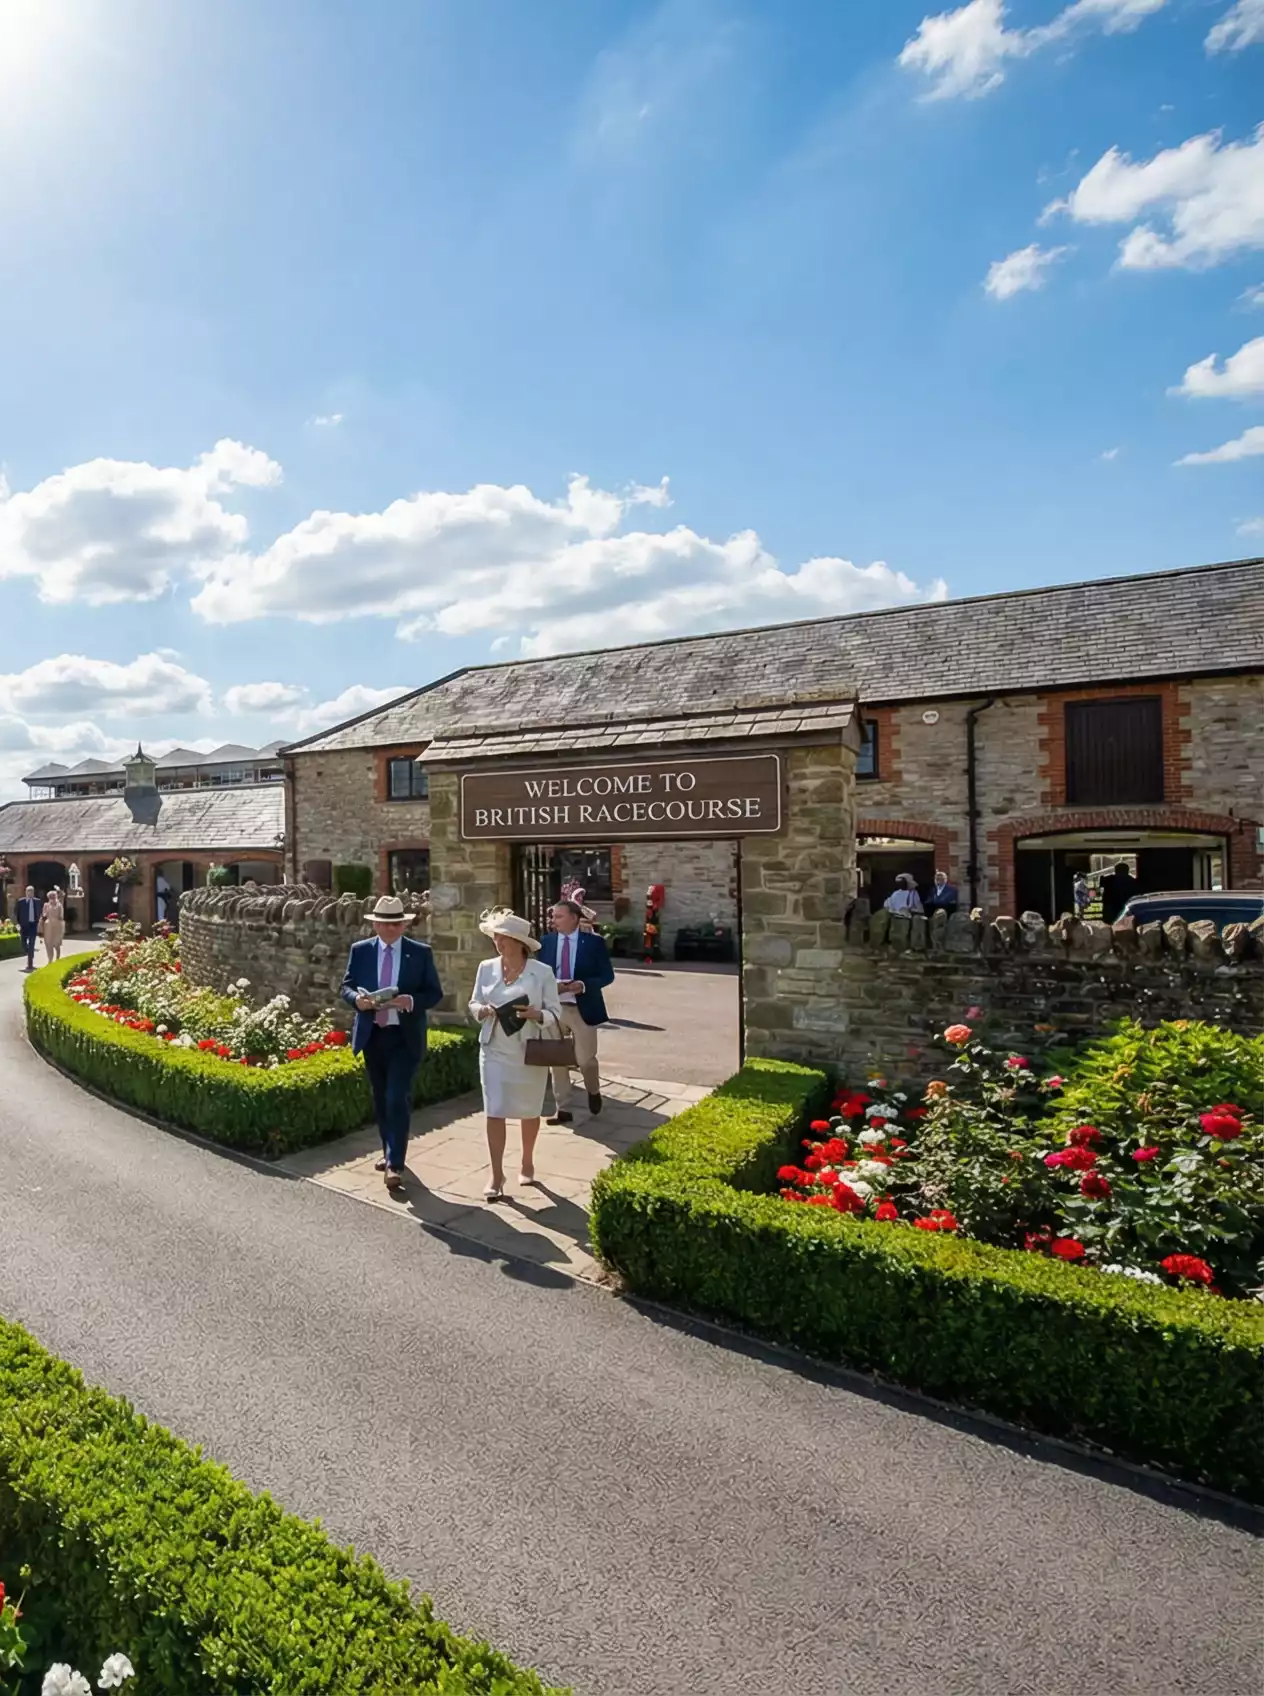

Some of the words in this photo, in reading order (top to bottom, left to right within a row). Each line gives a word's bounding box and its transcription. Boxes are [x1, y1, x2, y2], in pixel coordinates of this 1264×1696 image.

[523, 774, 653, 798] WELCOME
[659, 772, 696, 792] TO
[475, 804, 570, 827] BRITISH
[579, 797, 762, 823] RACECOURSE
